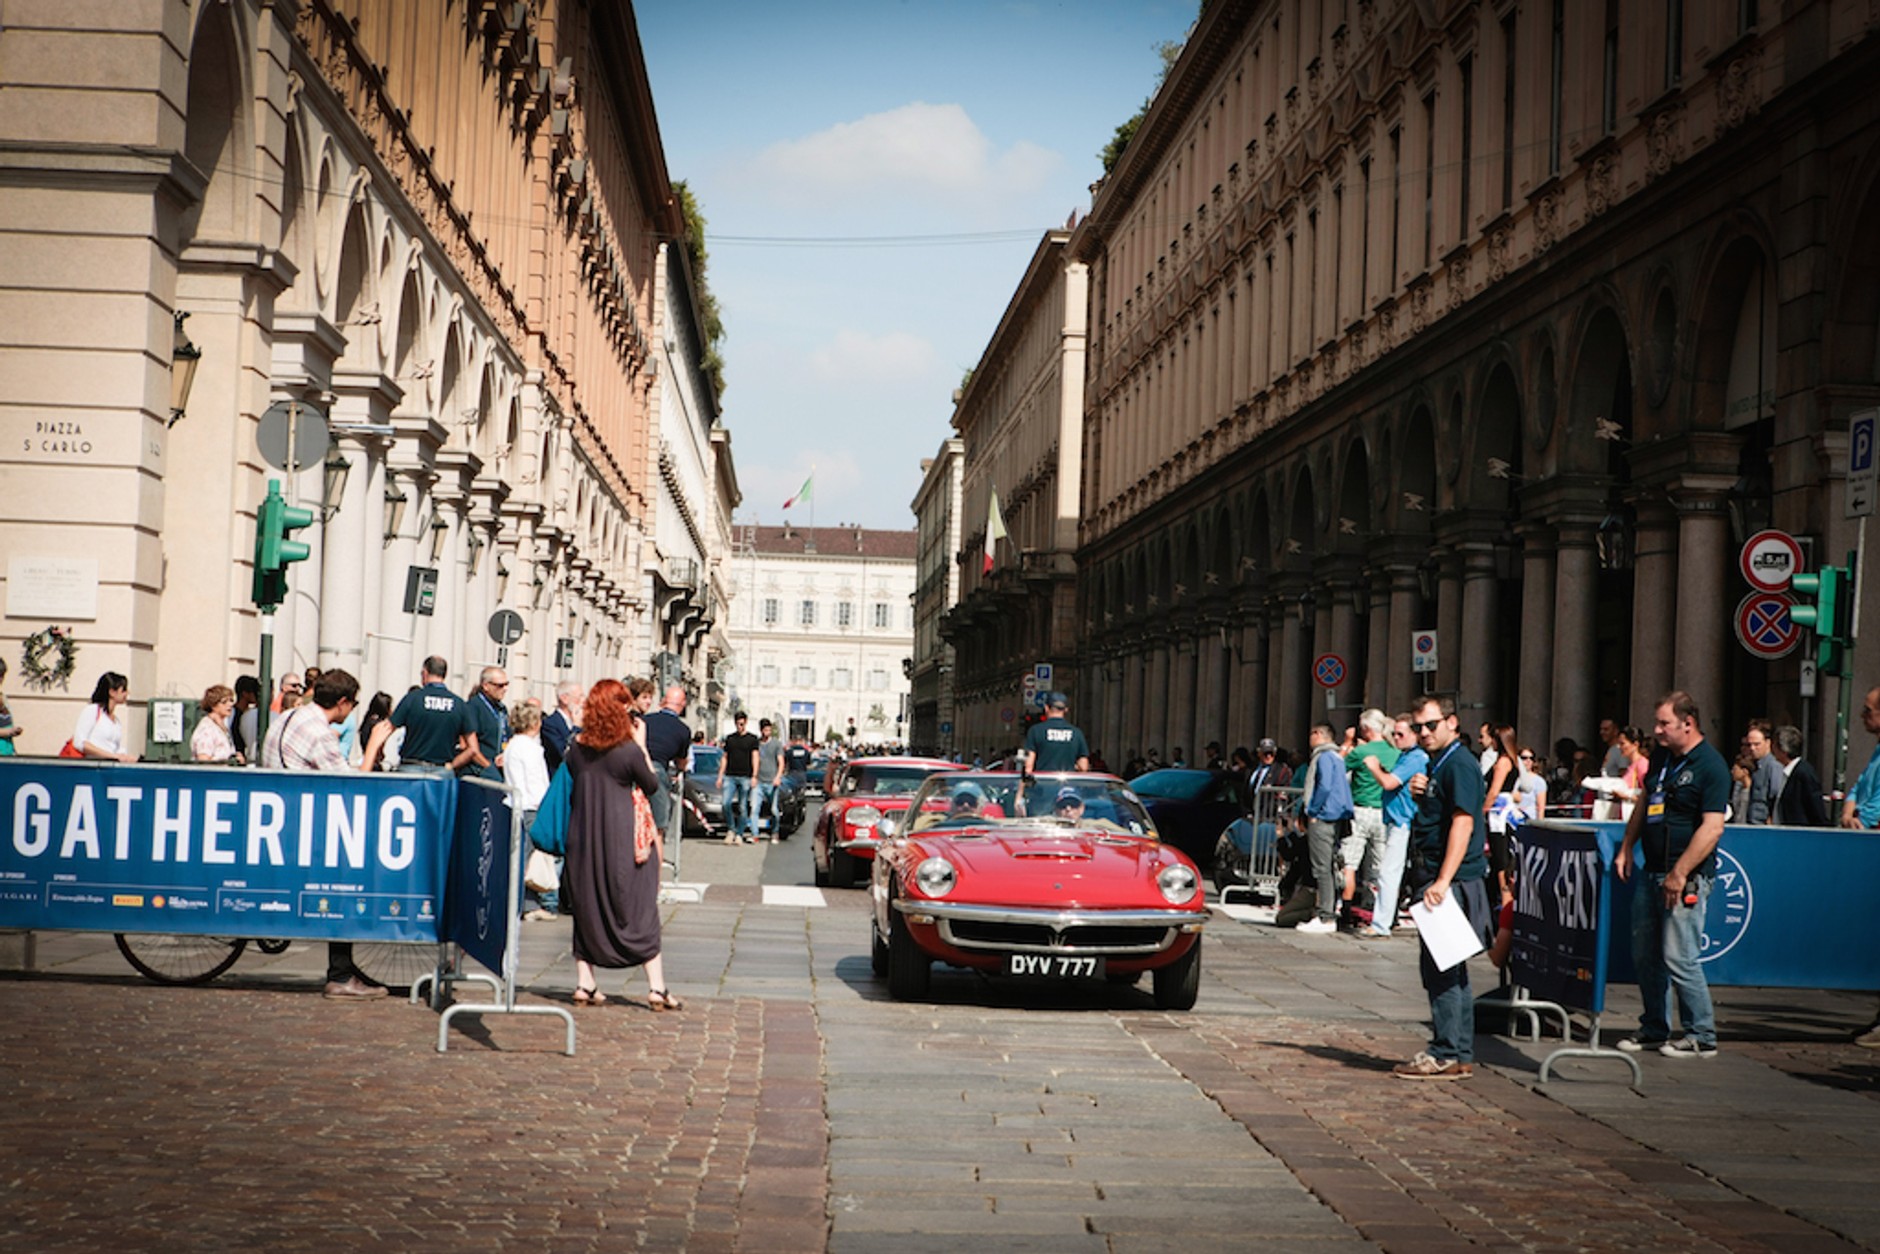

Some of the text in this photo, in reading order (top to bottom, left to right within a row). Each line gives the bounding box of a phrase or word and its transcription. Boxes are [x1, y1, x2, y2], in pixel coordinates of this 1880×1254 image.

[36, 422, 82, 435] PIAZZA
[24, 439, 93, 454] S CARLO
[1856, 432, 1870, 469] P
[424, 695, 455, 711] STAFF
[1046, 728, 1073, 742] STAFF
[12, 782, 418, 871] GATHERING
[1011, 955, 1097, 976] DYV 777
